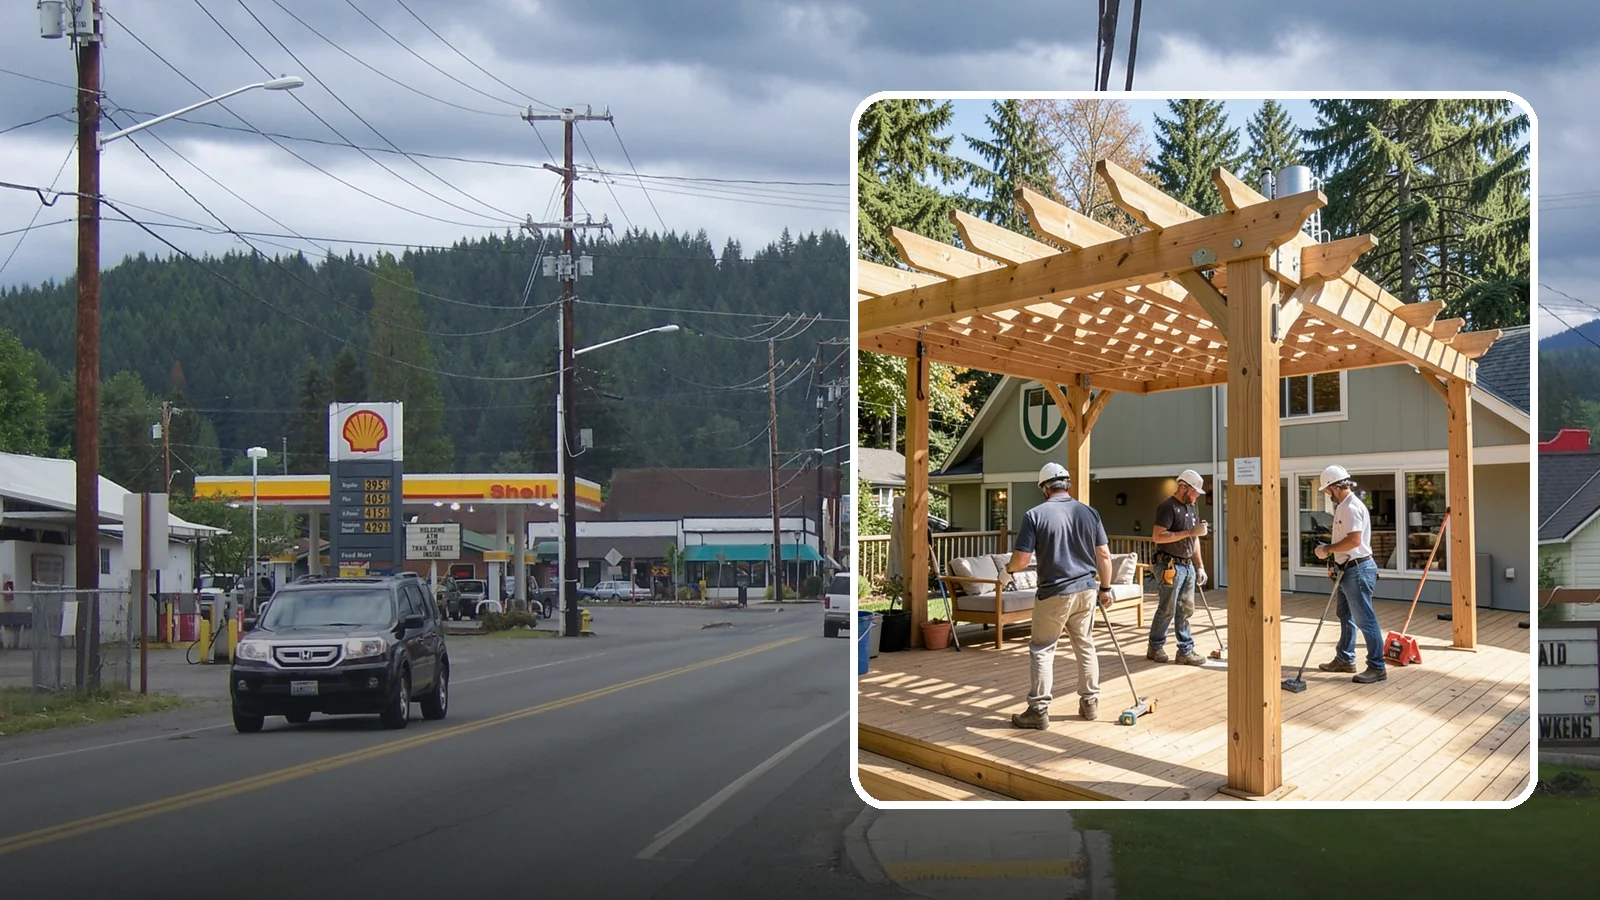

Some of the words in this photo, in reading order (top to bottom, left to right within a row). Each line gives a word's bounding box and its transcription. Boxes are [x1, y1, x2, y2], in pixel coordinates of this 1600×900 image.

[366, 480, 384, 490] 395
[489, 484, 547, 499] Shell
[366, 494, 384, 504] 405
[366, 508, 383, 518] 415
[366, 522, 384, 533] 429
